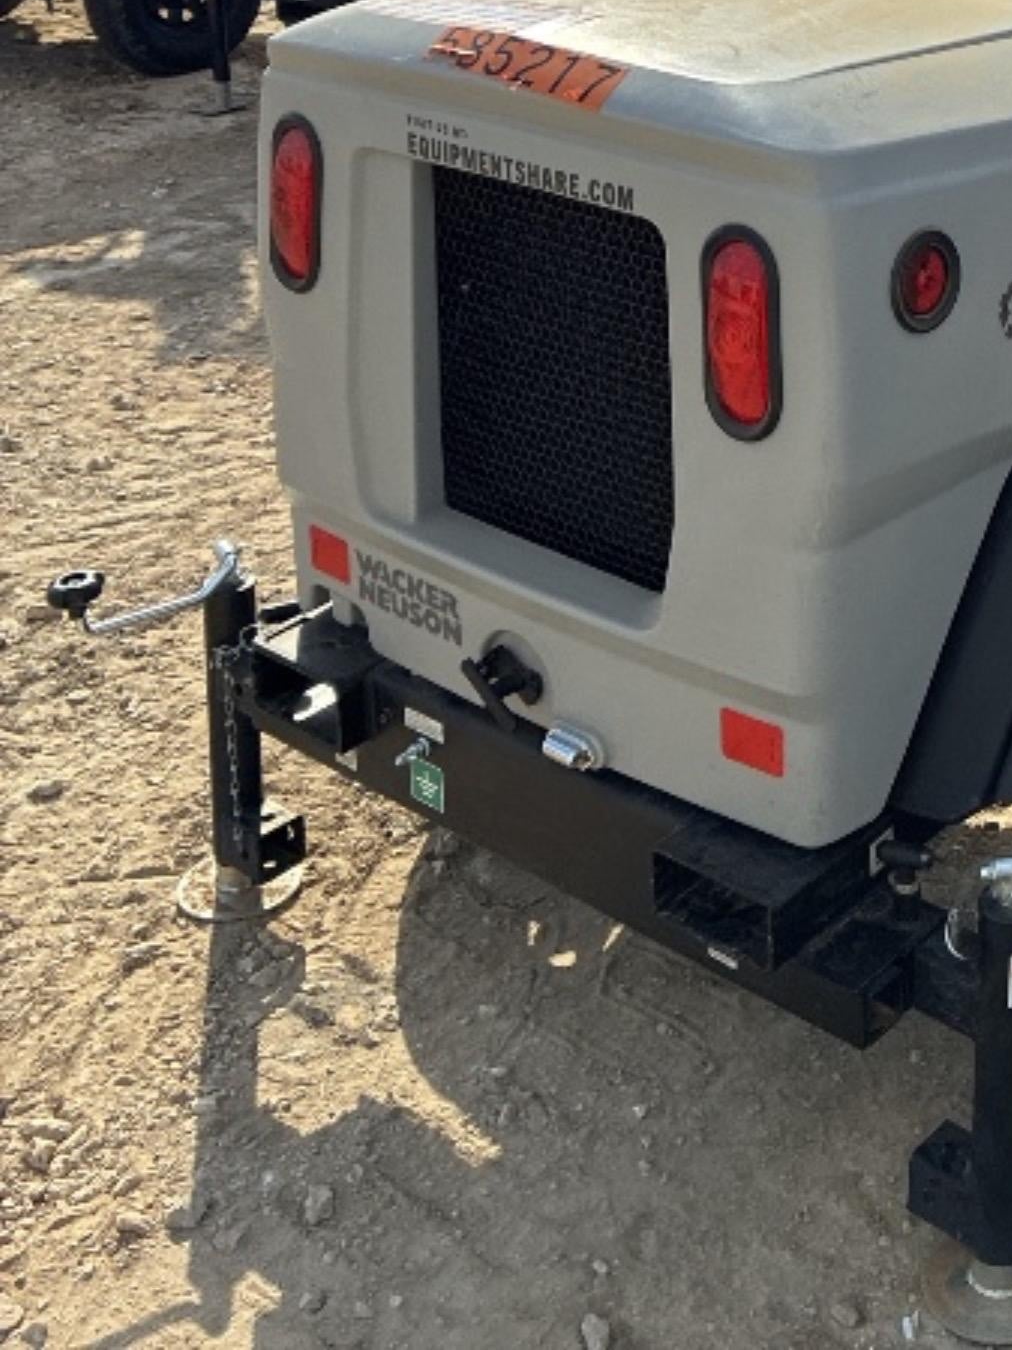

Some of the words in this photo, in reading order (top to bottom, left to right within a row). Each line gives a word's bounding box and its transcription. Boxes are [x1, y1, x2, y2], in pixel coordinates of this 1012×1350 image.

[406, 131, 635, 211] EQUIPMENTSHARE.COM
[355, 548, 460, 618] WACKER
[357, 582, 463, 646] NEUSON
